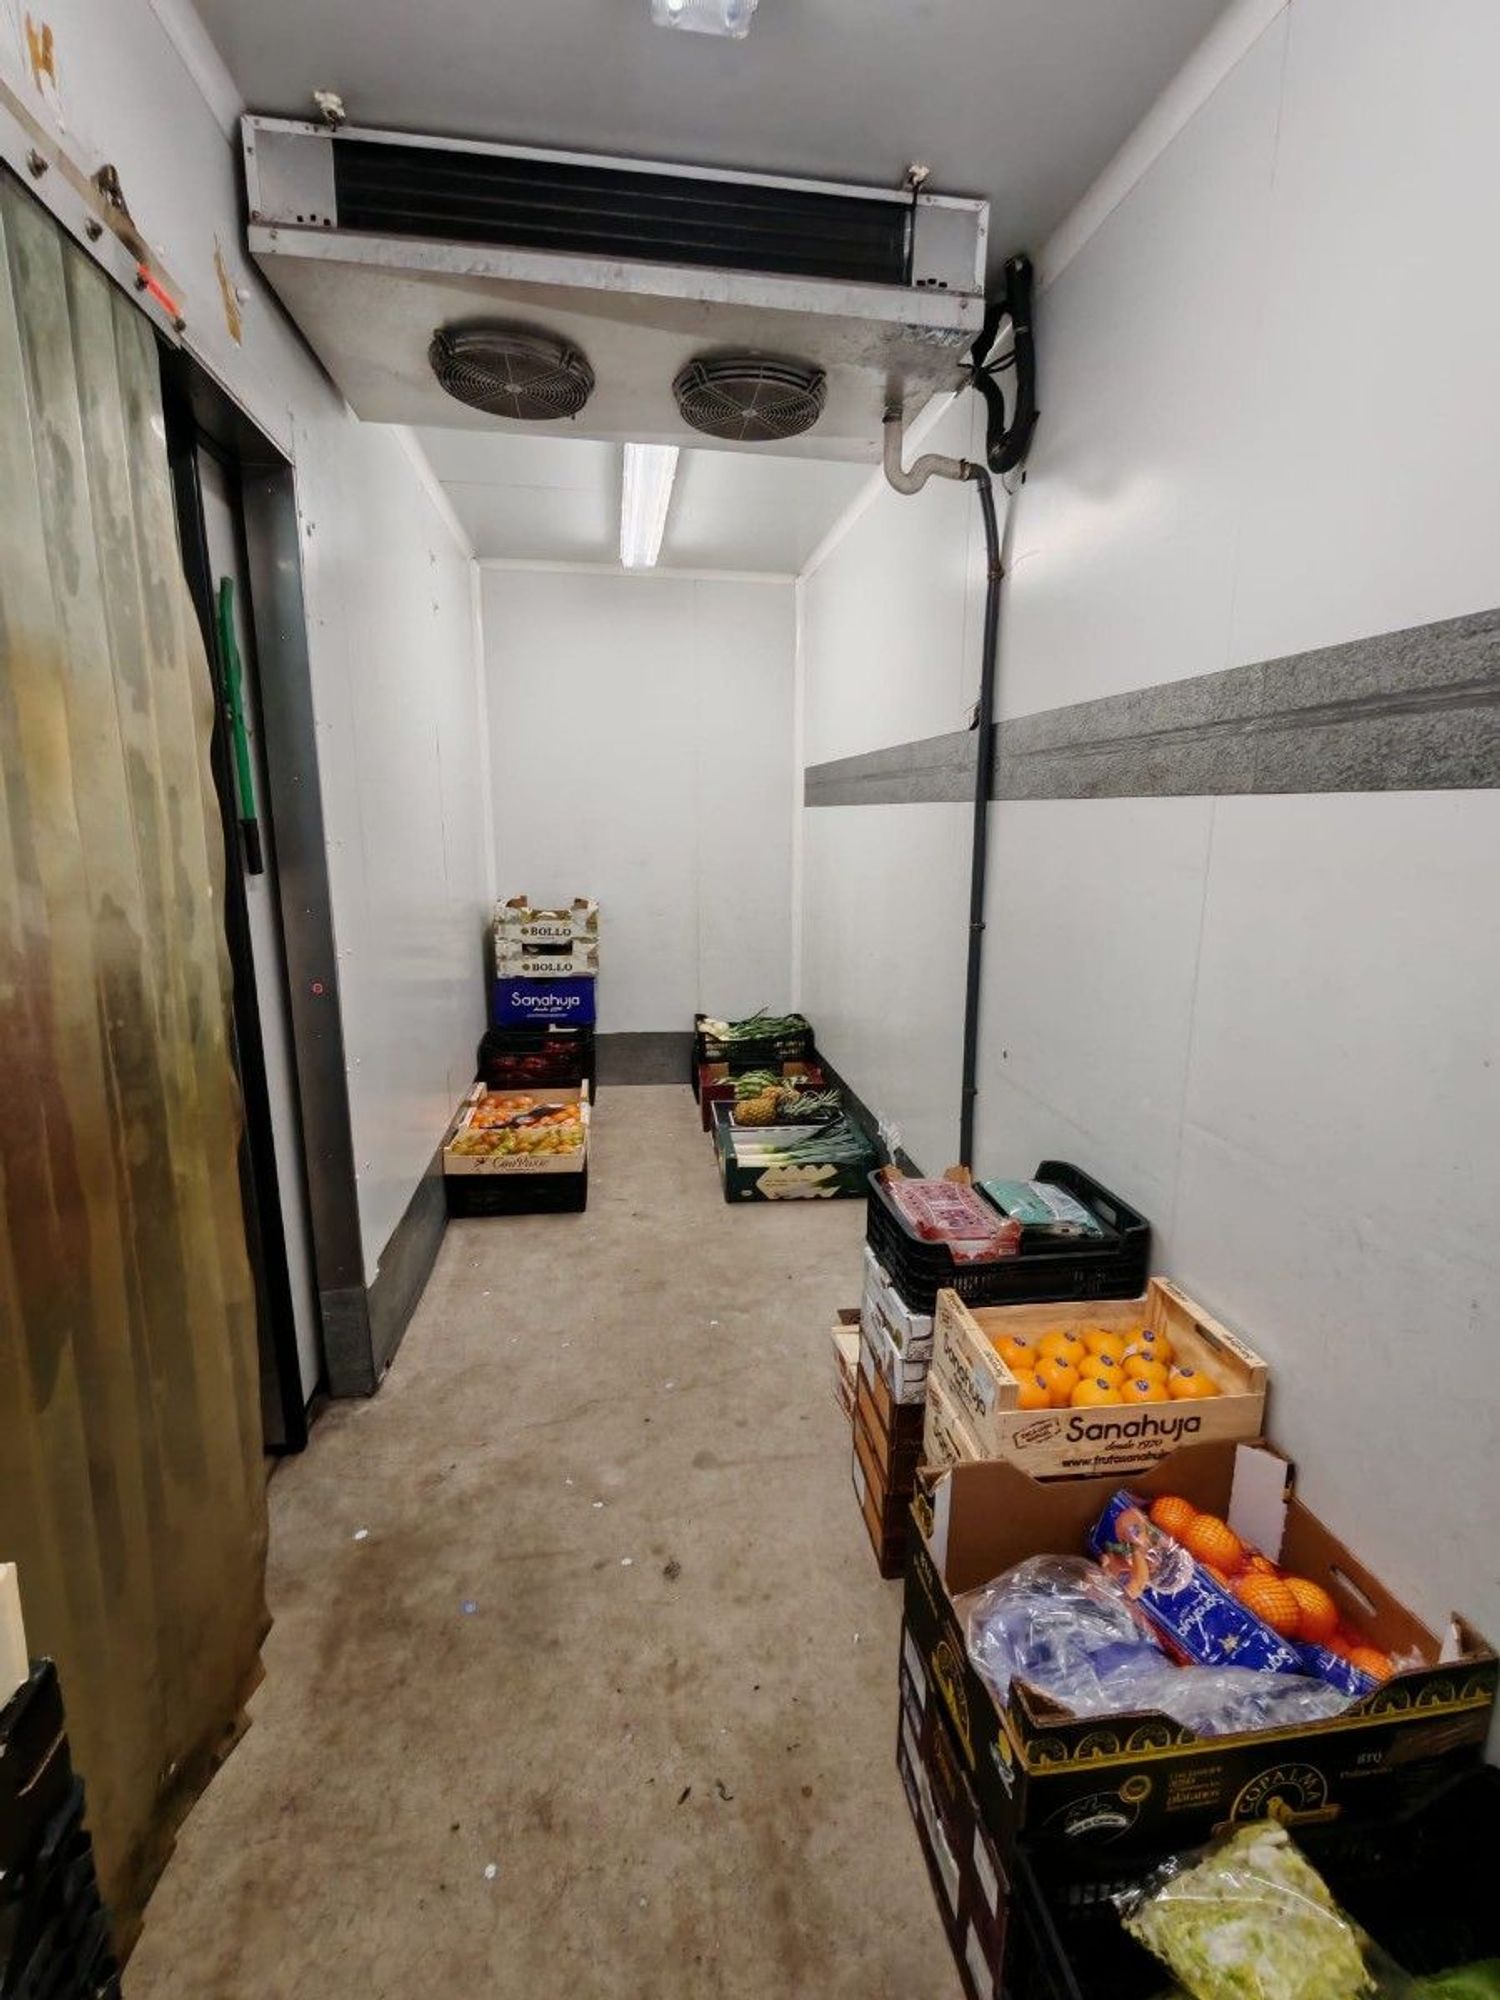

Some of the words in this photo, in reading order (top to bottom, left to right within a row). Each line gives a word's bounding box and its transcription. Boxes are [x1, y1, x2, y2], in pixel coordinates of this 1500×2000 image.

[530, 927, 572, 937] BOLLO
[531, 963, 573, 972] BOLLO
[511, 992, 580, 1009] Sanahuja
[1066, 1414, 1201, 1442] Sanahuja
[1178, 1591, 1225, 1636] Sanahuja
[1239, 1768, 1322, 1814] COPALMA
